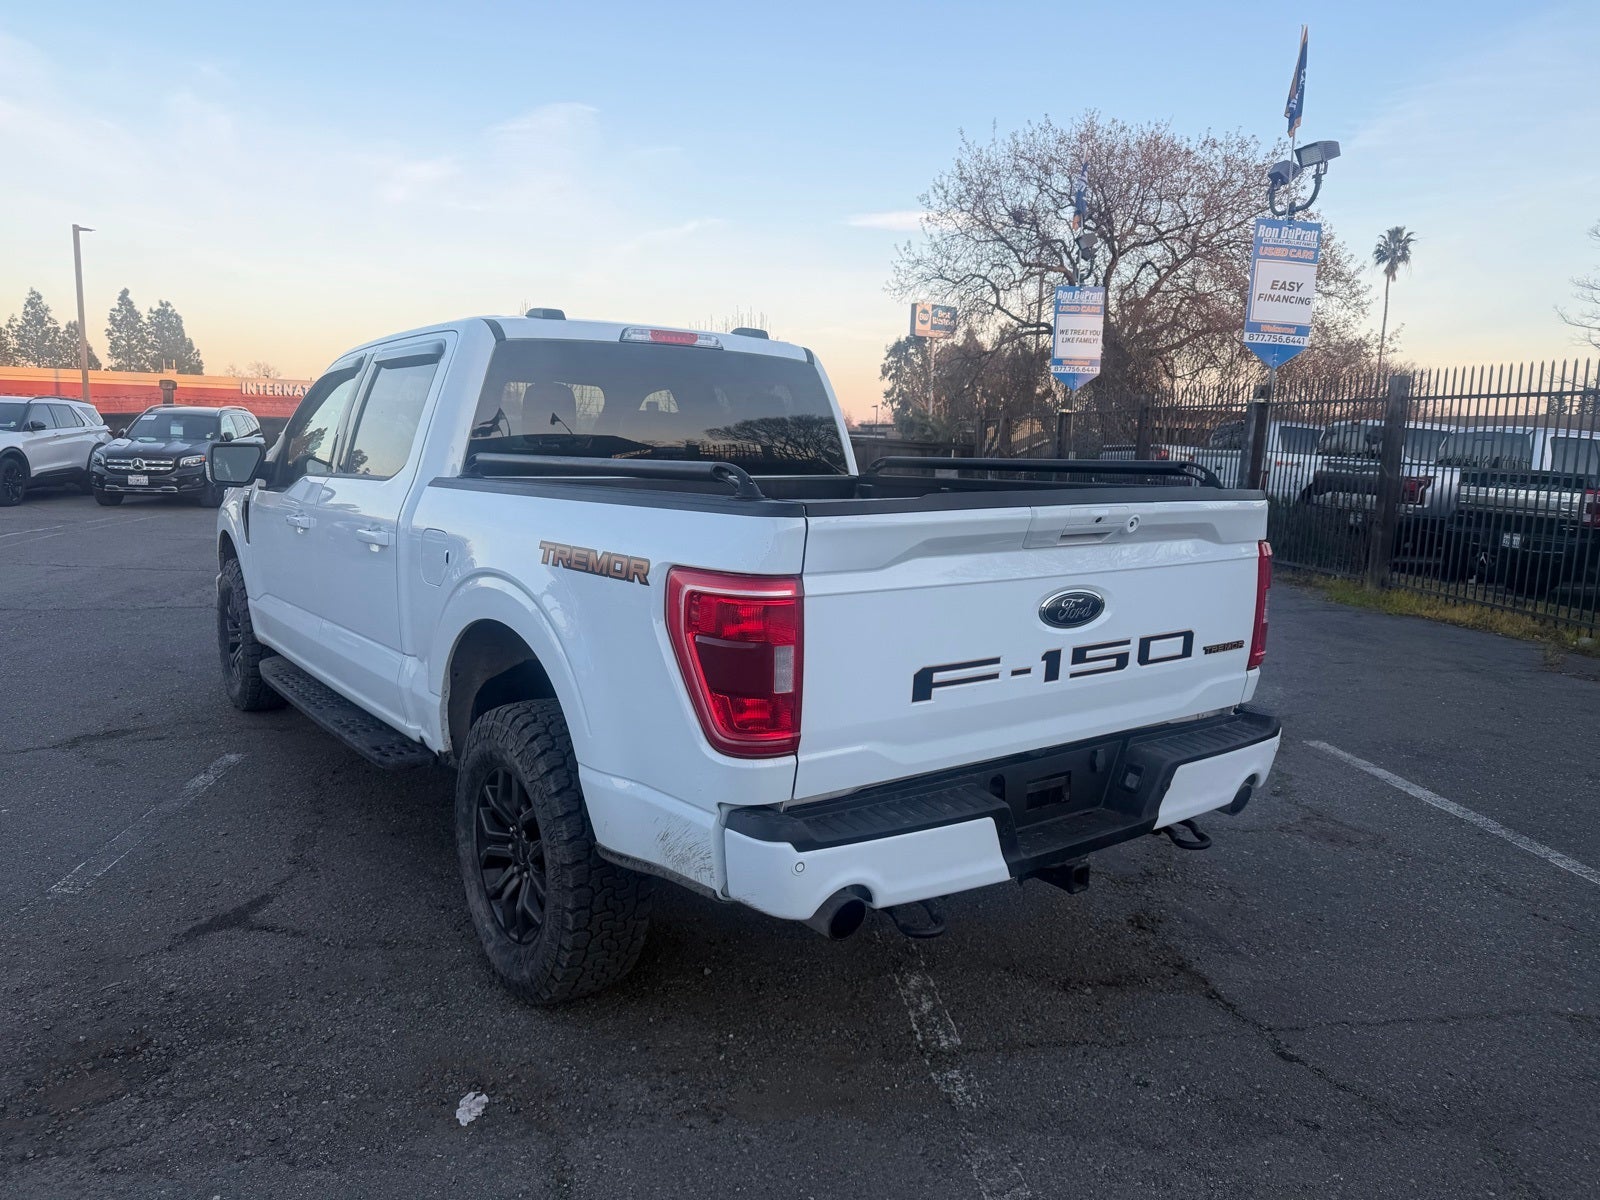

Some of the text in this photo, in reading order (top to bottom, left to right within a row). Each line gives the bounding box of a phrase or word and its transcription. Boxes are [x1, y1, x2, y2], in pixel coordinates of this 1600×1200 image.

[1258, 224, 1319, 242] Ron DuPratt
[1259, 246, 1315, 260] USED CARS
[1270, 279, 1304, 292] EASY
[1057, 290, 1074, 300] Ron
[1257, 293, 1311, 306] FINANCING
[1248, 333, 1305, 345] 877.756.6441
[539, 540, 651, 586] TREMOR
[1057, 598, 1093, 620] Ford
[1203, 640, 1245, 655] TREMOR
[911, 629, 1195, 703] F-150
